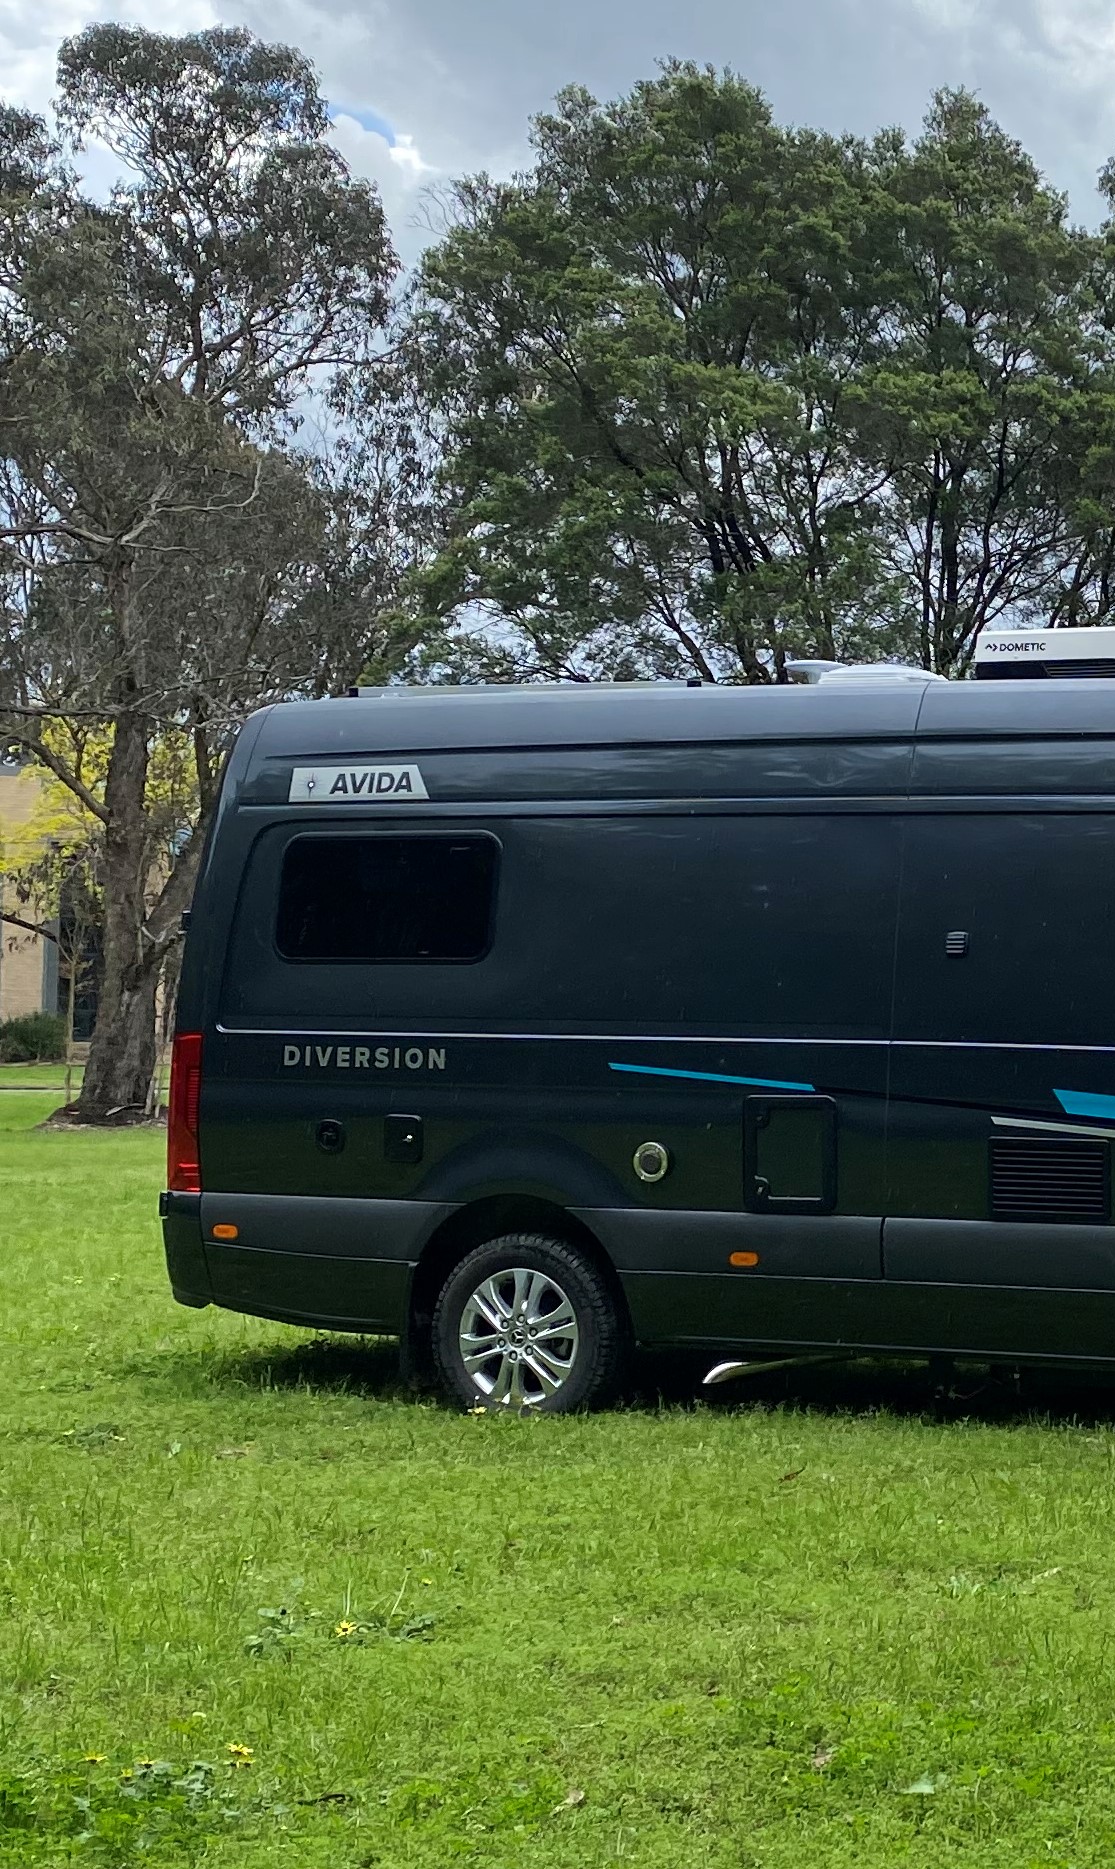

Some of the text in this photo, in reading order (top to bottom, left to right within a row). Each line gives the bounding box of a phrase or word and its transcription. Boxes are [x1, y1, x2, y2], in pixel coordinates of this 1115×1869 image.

[999, 643, 1047, 652] DOMETIC
[329, 771, 413, 795] AVIDA
[283, 1045, 447, 1070] DIVERSION
